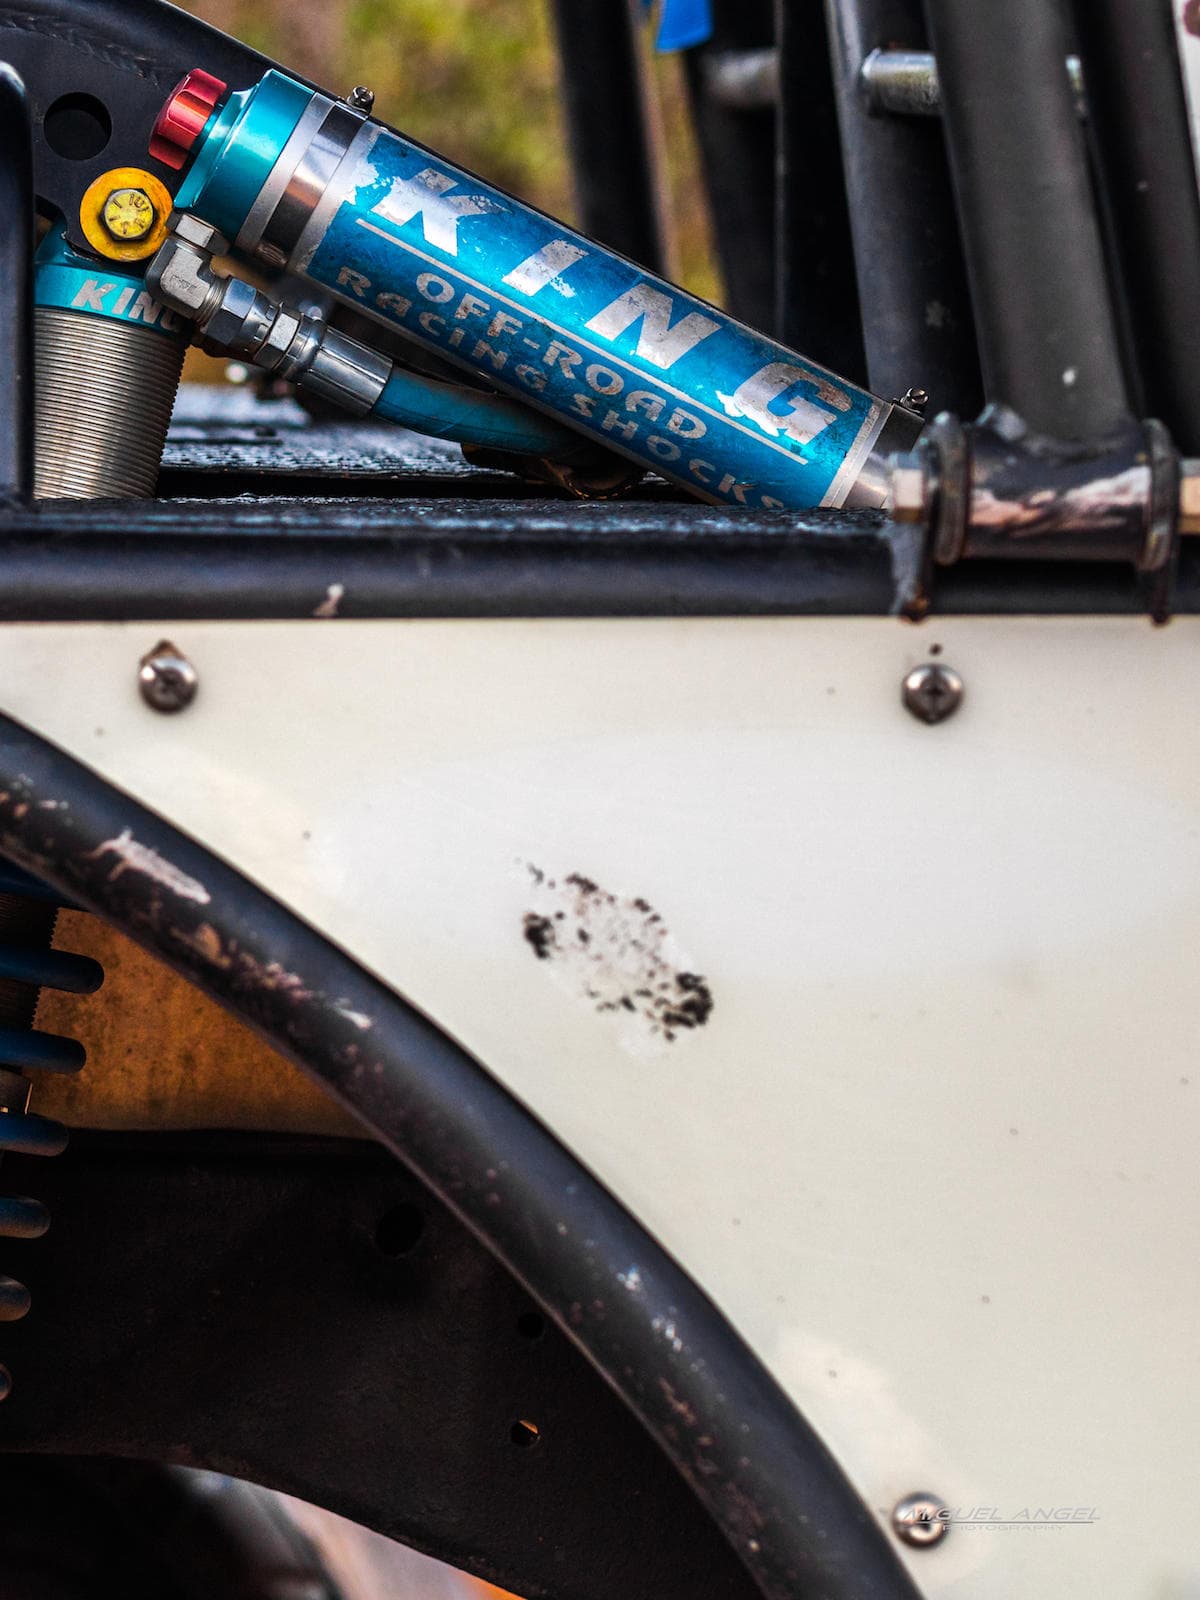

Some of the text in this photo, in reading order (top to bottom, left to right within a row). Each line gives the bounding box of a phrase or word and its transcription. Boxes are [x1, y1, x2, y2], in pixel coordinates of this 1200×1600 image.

[336, 266, 549, 392] RACING
[370, 167, 854, 446] KING
[416, 272, 707, 439] OFF-ROAD
